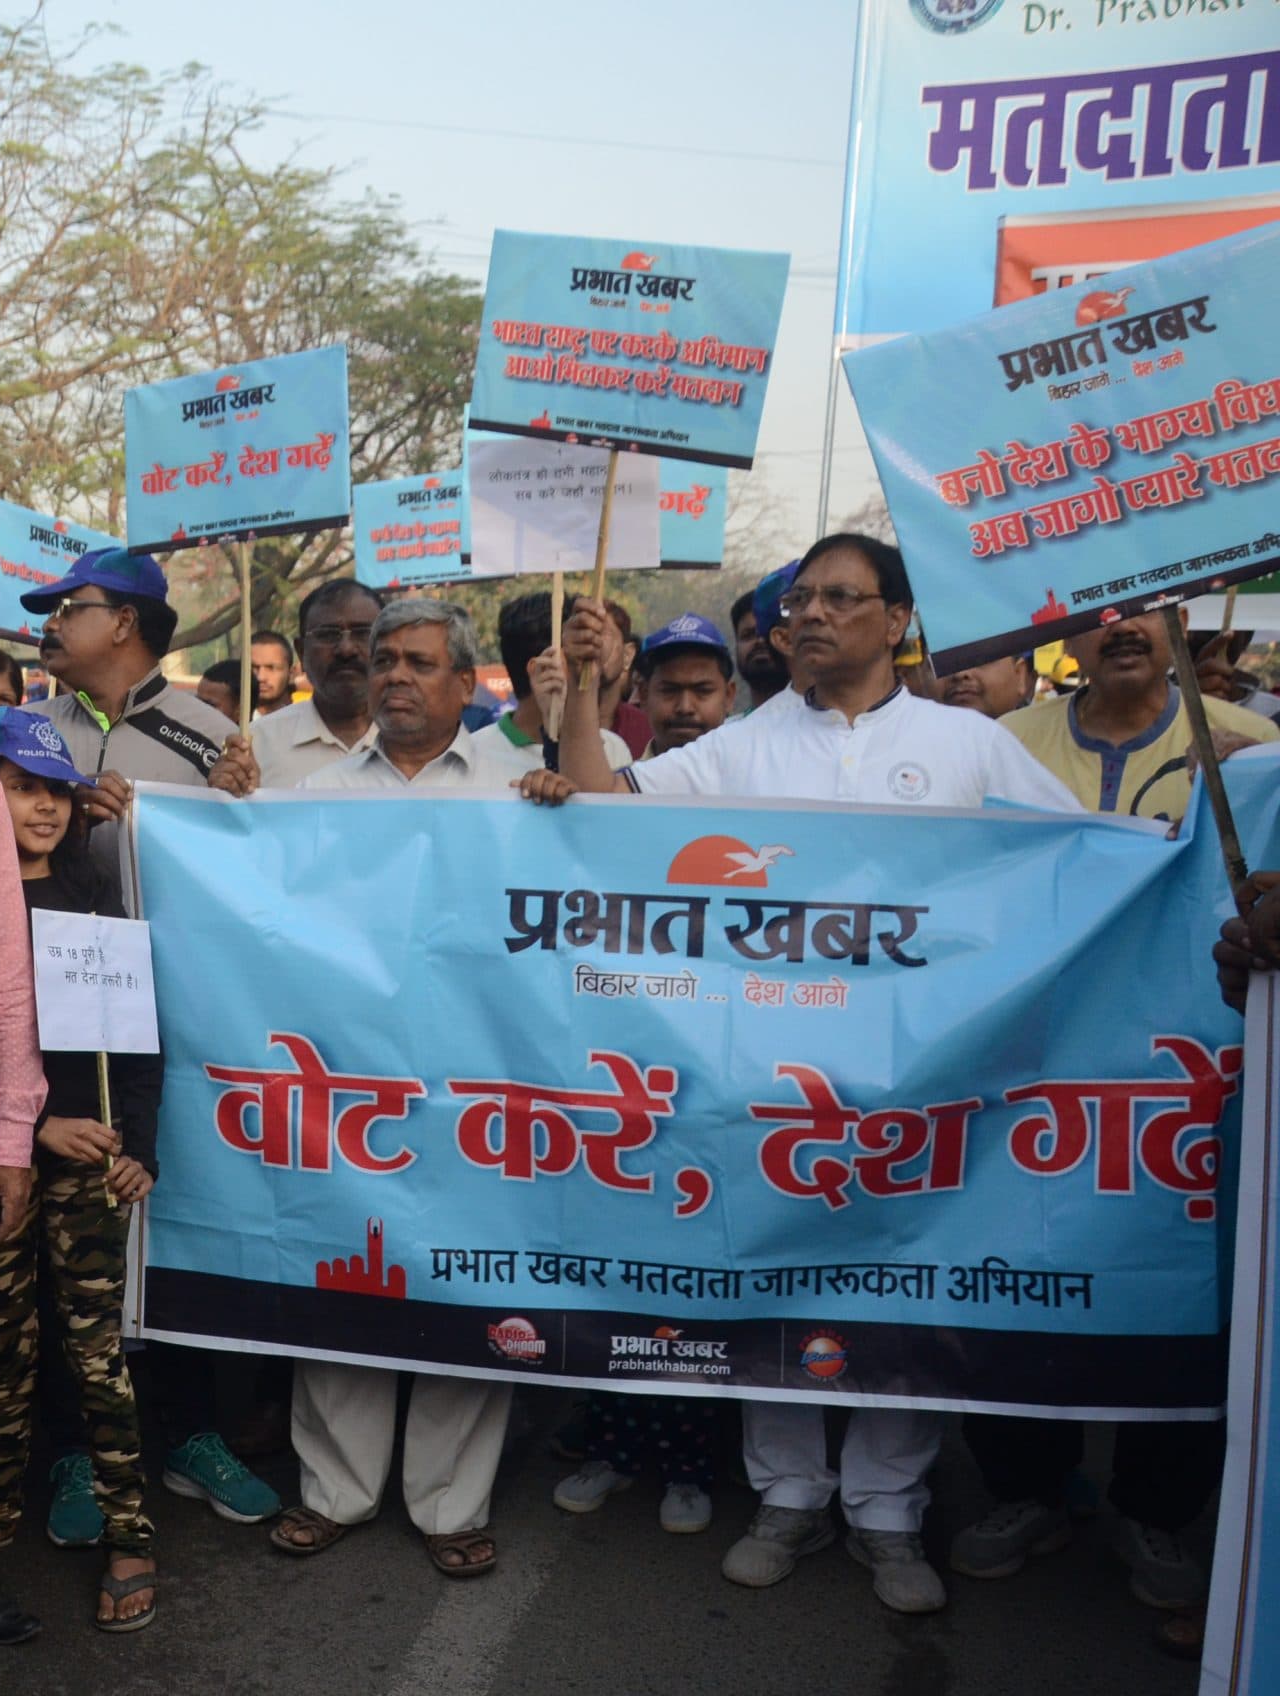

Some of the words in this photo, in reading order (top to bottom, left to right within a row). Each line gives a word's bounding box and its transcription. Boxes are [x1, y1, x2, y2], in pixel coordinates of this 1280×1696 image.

[1023, 3, 1072, 33] Dr.
[1097, 0, 1245, 26] Praba
[570, 268, 632, 295] प्रभात
[636, 273, 696, 301] खबर
[492, 319, 543, 347] भारत
[590, 328, 618, 353] पर
[620, 329, 676, 360] करके
[680, 335, 767, 373] अभिमान
[998, 327, 1108, 392] प्रभात
[1107, 296, 1217, 354] खबर
[505, 353, 554, 381] आओ
[555, 354, 631, 390] मिलकर
[672, 375, 742, 405] मतदान
[1048, 383, 1081, 401] बिहार
[182, 391, 227, 422] प्रभात
[229, 383, 276, 410] खबर
[140, 461, 180, 495] वोट
[238, 444, 280, 478] देश
[936, 450, 1006, 504] बनो
[1004, 440, 1069, 487] देश
[1066, 422, 1111, 468] के
[1114, 399, 1215, 454] भाग्य
[434, 485, 462, 501] खब
[969, 511, 1030, 558] अब
[1027, 475, 1122, 539] जागो
[1121, 453, 1204, 510] प्यारे
[30, 524, 59, 548] प्रभात
[1071, 584, 1104, 605] प्रभात
[1106, 575, 1137, 595] खबर
[1138, 561, 1184, 585] मतदाता
[160, 725, 205, 756] outlook
[504, 888, 710, 958] प्रभात
[724, 897, 929, 967] खबर
[67, 948, 78, 960] 18
[575, 964, 640, 996] बिहार
[644, 970, 698, 999] जागे
[745, 974, 786, 1006] देश
[792, 977, 848, 1008] आगे
[203, 1031, 427, 1174] वोट
[447, 1048, 712, 1217] करें,
[749, 1062, 983, 1210] देश
[431, 1248, 519, 1283] प्रभात
[527, 1251, 612, 1288] खबर
[619, 1259, 744, 1299] मतदाता
[752, 1263, 938, 1299] जागरूकता
[947, 1255, 1094, 1309] अभियान
[608, 1359, 731, 1375] prabhatkhabar.com
[611, 1336, 668, 1356] प्रभात
[672, 1341, 728, 1359] खबर
